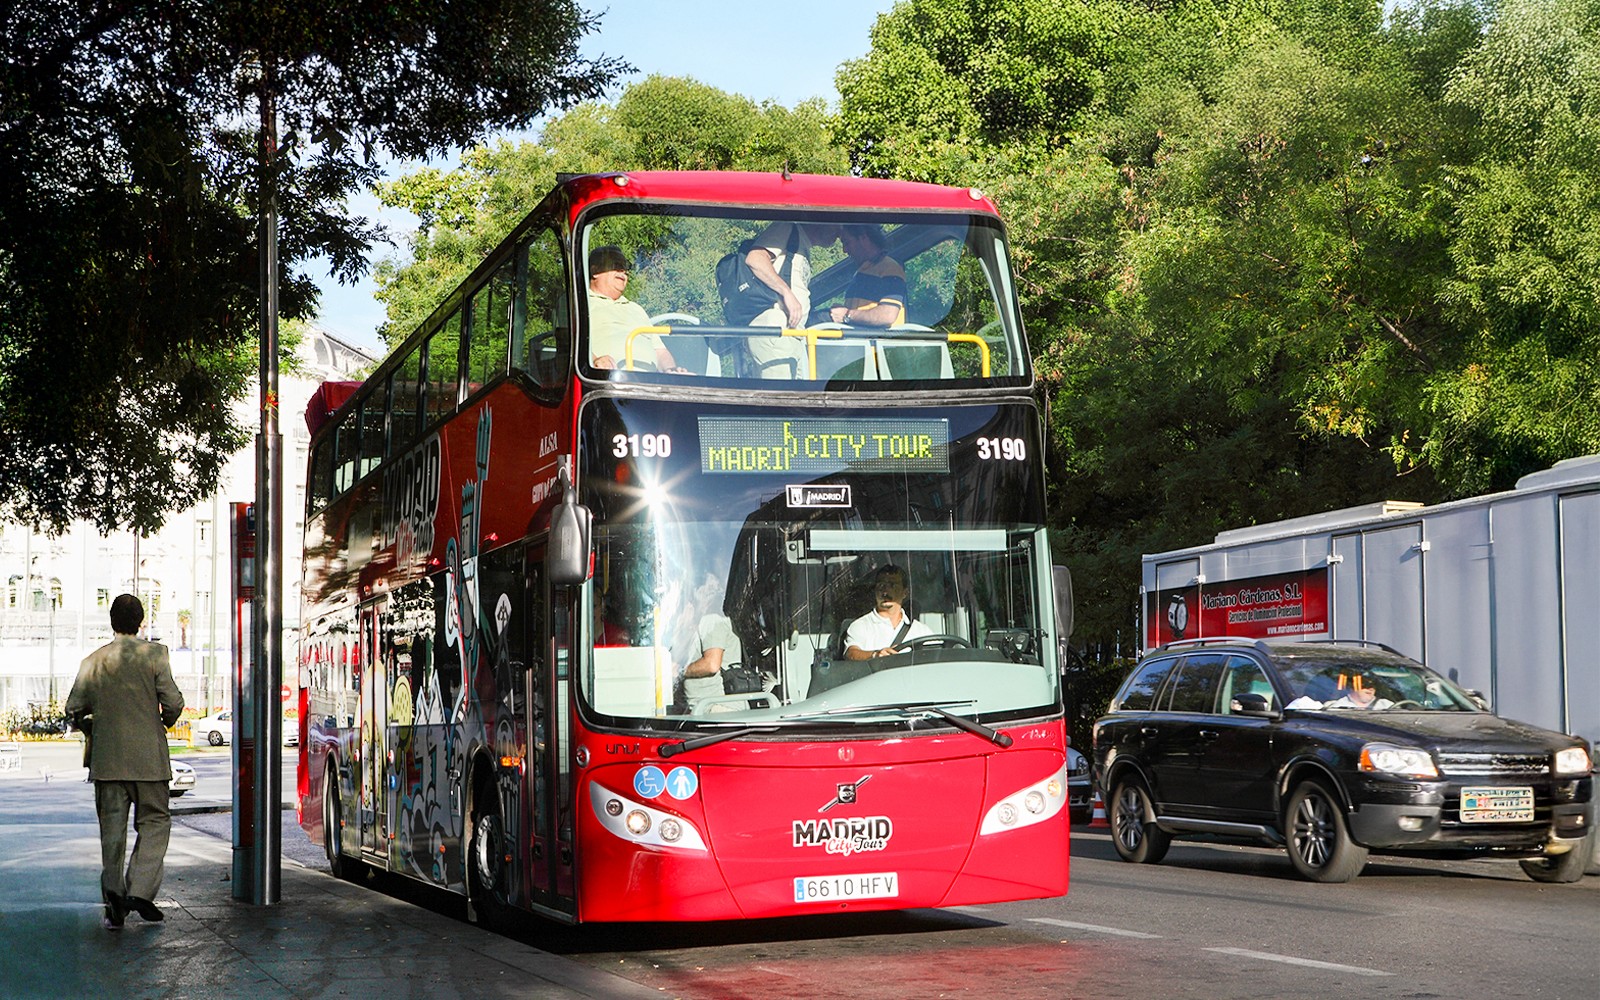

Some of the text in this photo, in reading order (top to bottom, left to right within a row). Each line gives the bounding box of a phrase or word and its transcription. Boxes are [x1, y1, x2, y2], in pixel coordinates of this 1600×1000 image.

[539, 431, 558, 458] ALSA
[612, 433, 671, 458] 3190
[804, 434, 866, 458] CITY
[872, 434, 932, 458] TOUR
[976, 436, 1026, 461] 3190
[806, 488, 846, 505] ¡MADRID!
[1202, 582, 1302, 610] Mariano Cárdenas, S.L.
[794, 818, 891, 846] MADRID
[853, 836, 884, 851] Tour
[807, 878, 854, 898] 6610
[860, 876, 894, 895] HFV
